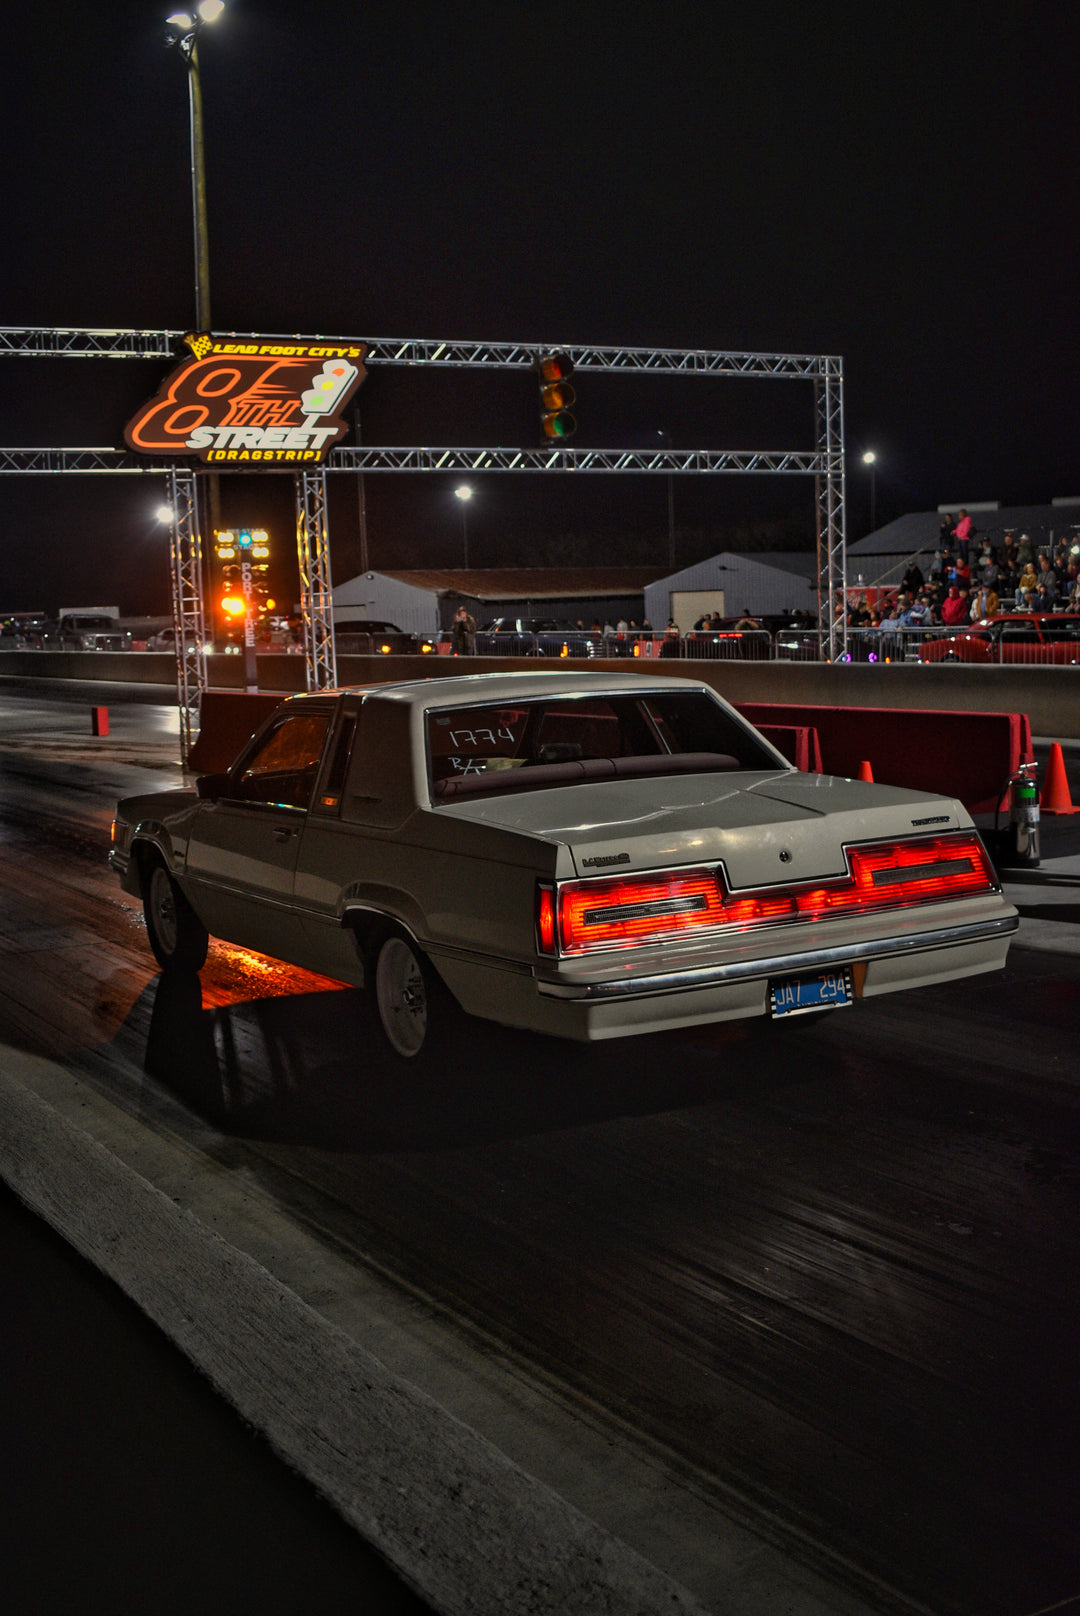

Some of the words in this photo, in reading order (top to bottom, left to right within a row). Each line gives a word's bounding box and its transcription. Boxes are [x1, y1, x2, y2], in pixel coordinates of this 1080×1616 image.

[212, 344, 259, 355] LEAD
[259, 345, 308, 356] FOOT
[308, 346, 361, 358] CITY'S
[185, 426, 339, 450] STREET
[241, 562, 255, 647] PORTTREE
[449, 727, 515, 748] 1774
[776, 979, 801, 1006] JA7
[817, 972, 846, 998] 294
